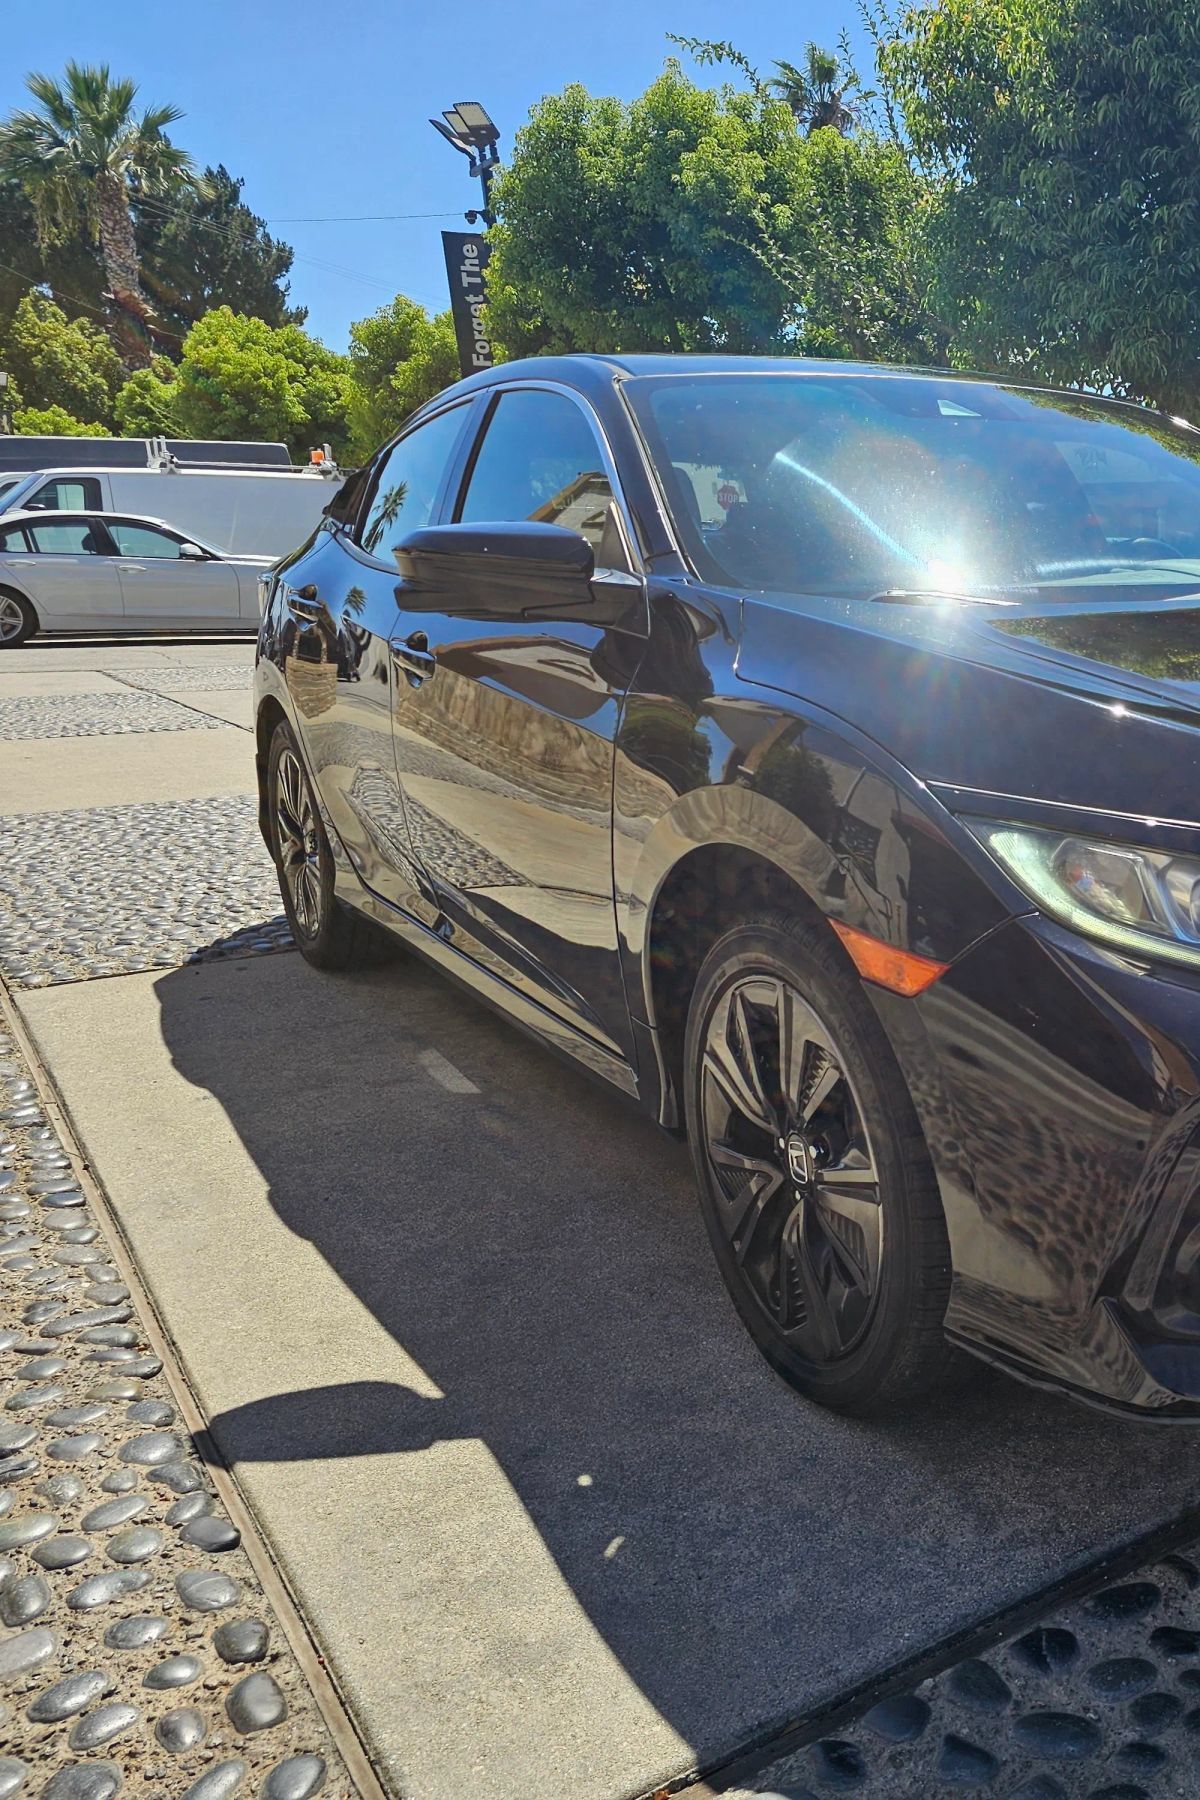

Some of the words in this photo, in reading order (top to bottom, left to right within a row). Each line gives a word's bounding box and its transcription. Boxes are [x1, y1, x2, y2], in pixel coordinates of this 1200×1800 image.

[460, 243, 482, 287] The
[464, 294, 492, 367] Forget
[718, 493, 738, 504] STOP
